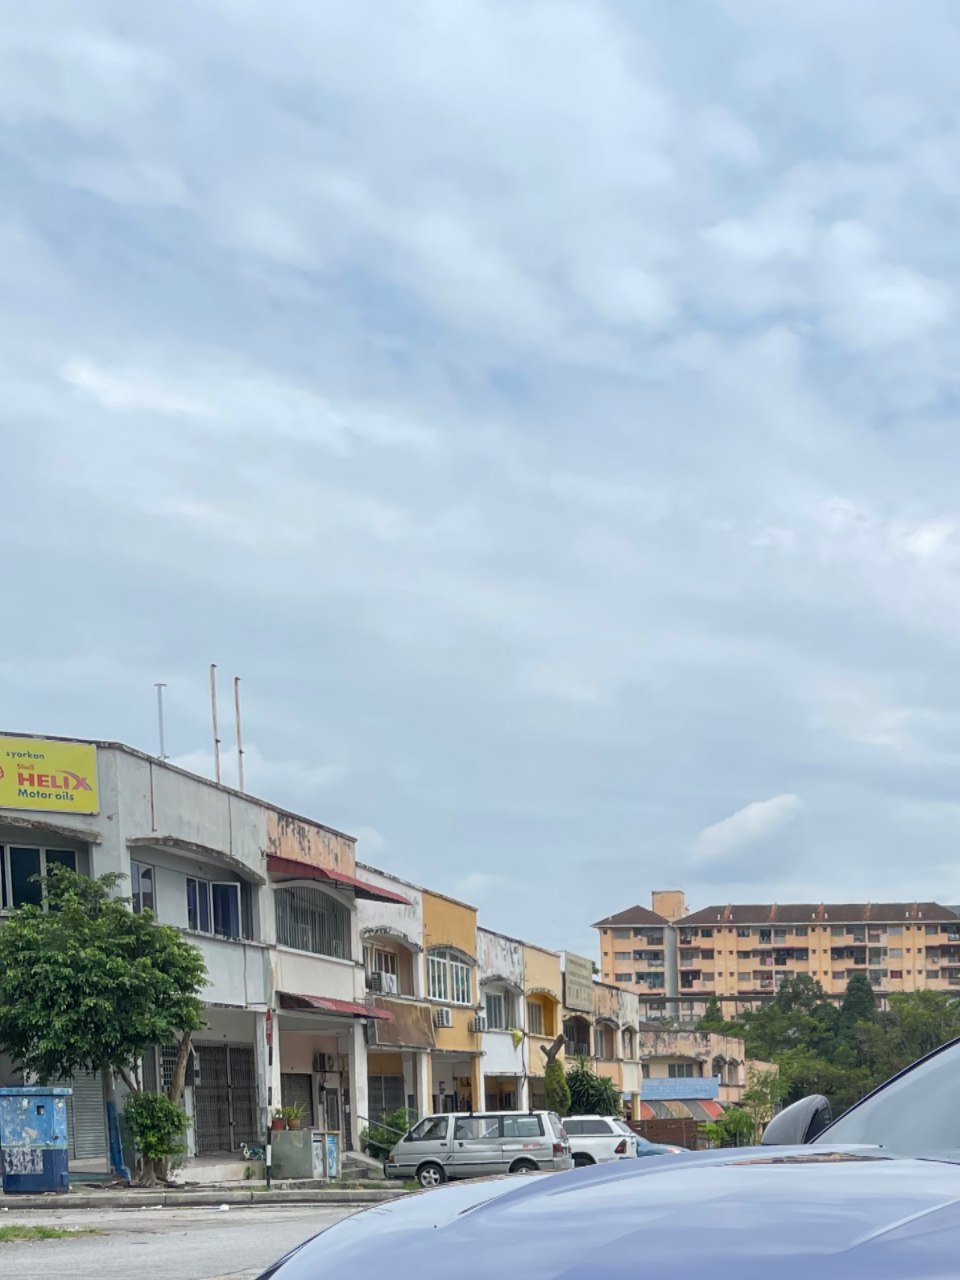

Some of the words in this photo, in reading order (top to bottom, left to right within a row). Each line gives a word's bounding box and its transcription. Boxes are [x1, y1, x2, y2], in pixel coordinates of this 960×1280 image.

[16, 763, 34, 771] Shell
[17, 771, 93, 791] HELIX
[17, 788, 52, 800] Motor
[55, 791, 74, 801] oils
